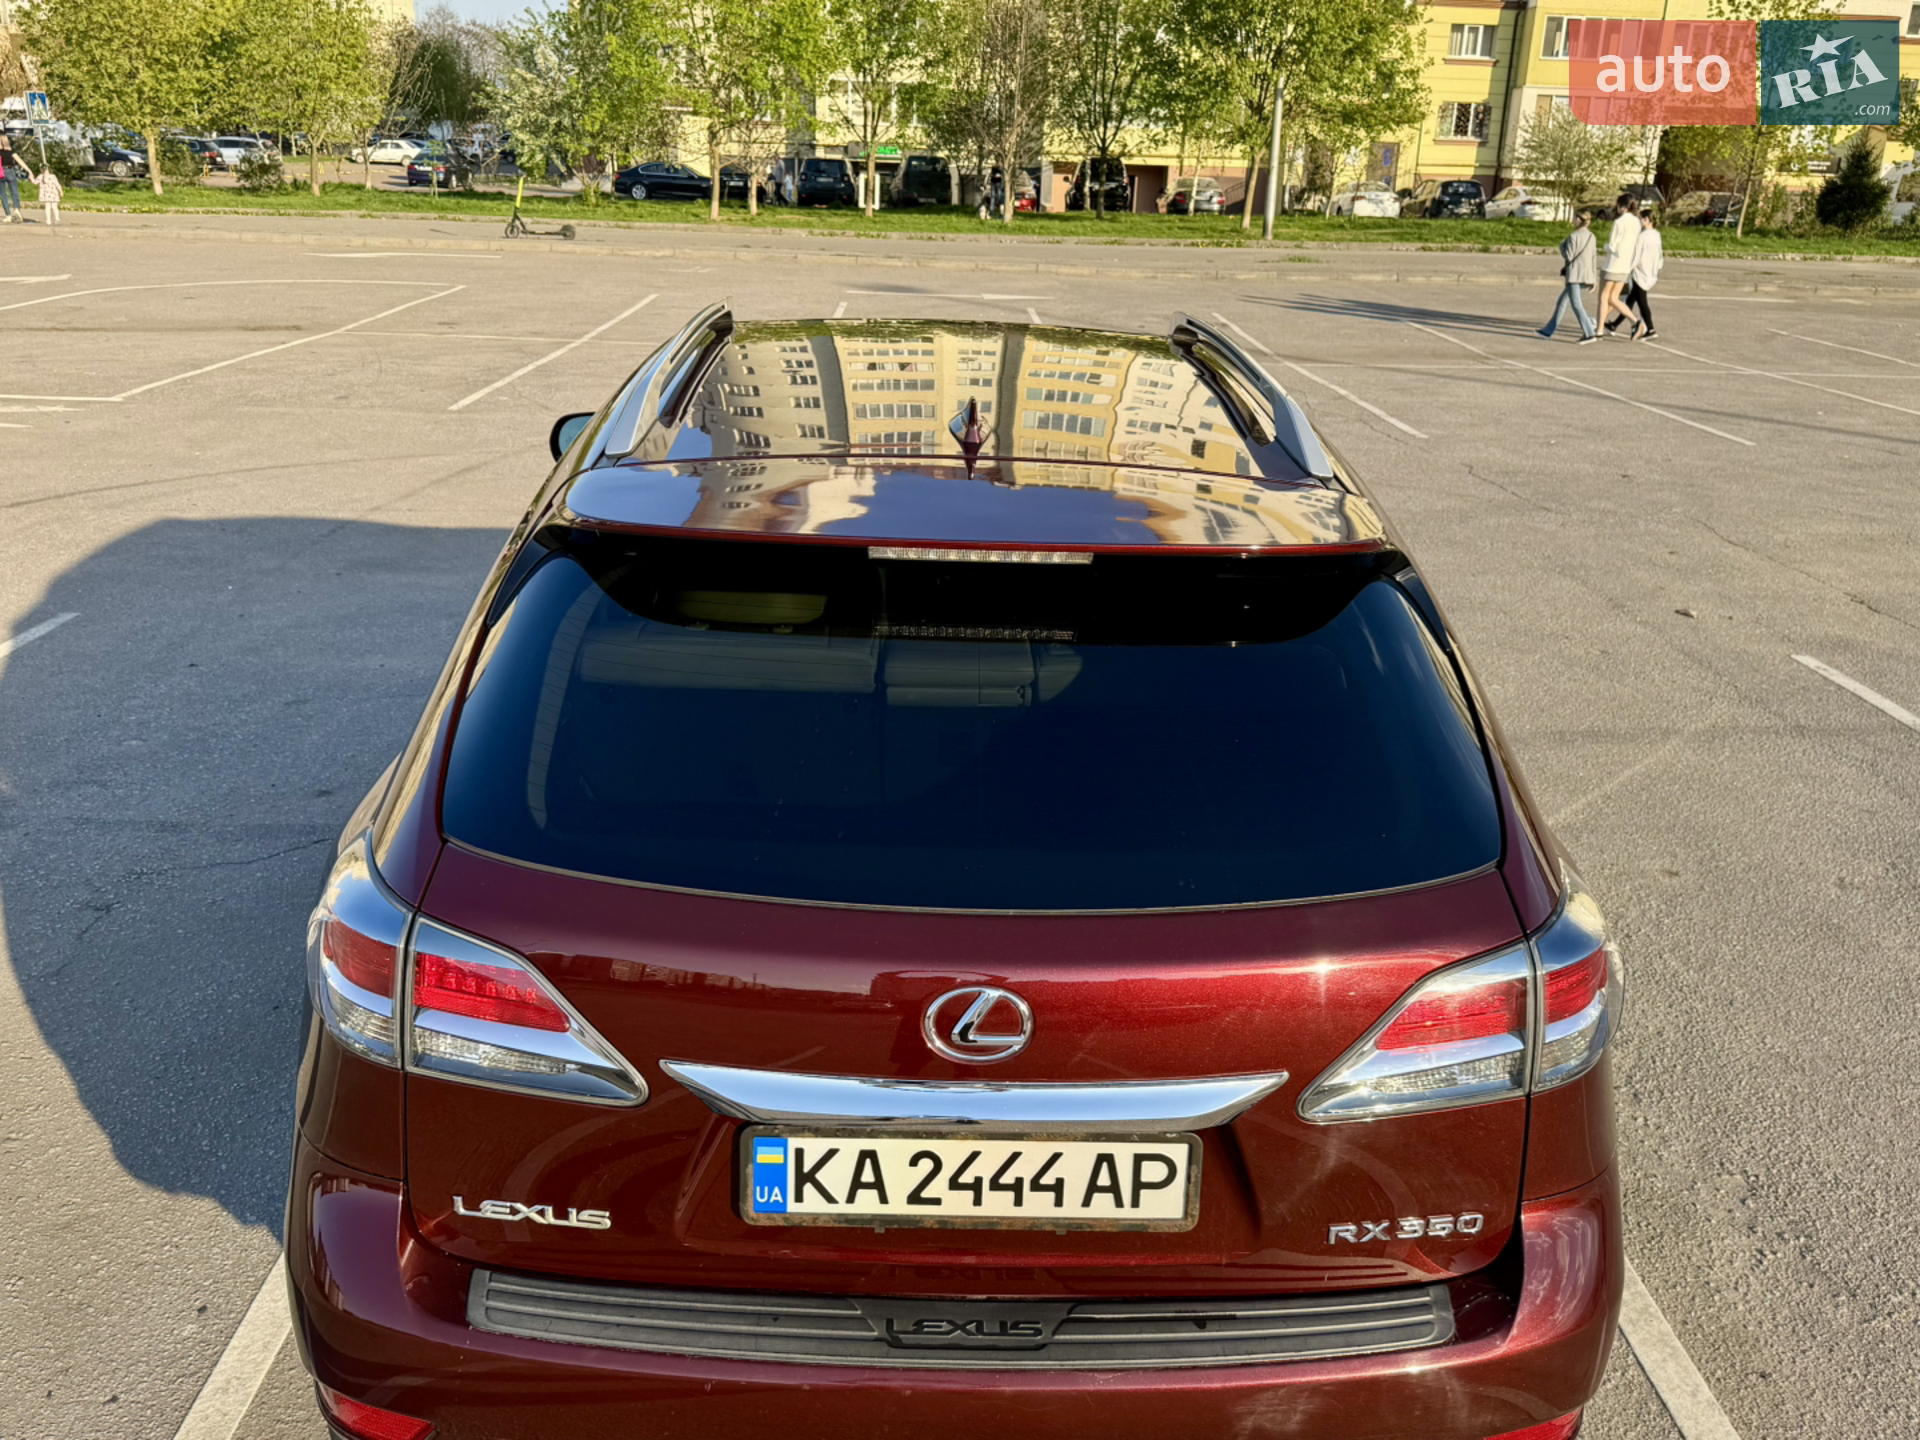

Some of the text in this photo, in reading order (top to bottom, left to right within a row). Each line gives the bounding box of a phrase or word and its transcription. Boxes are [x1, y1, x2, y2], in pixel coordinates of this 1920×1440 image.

[756, 1185, 785, 1204] UA
[793, 1147, 1178, 1209] KA 2444 AP
[452, 1195, 612, 1230] LEXUS
[1327, 1210, 1485, 1245] RX 350
[885, 1317, 1044, 1339] LEXUS
